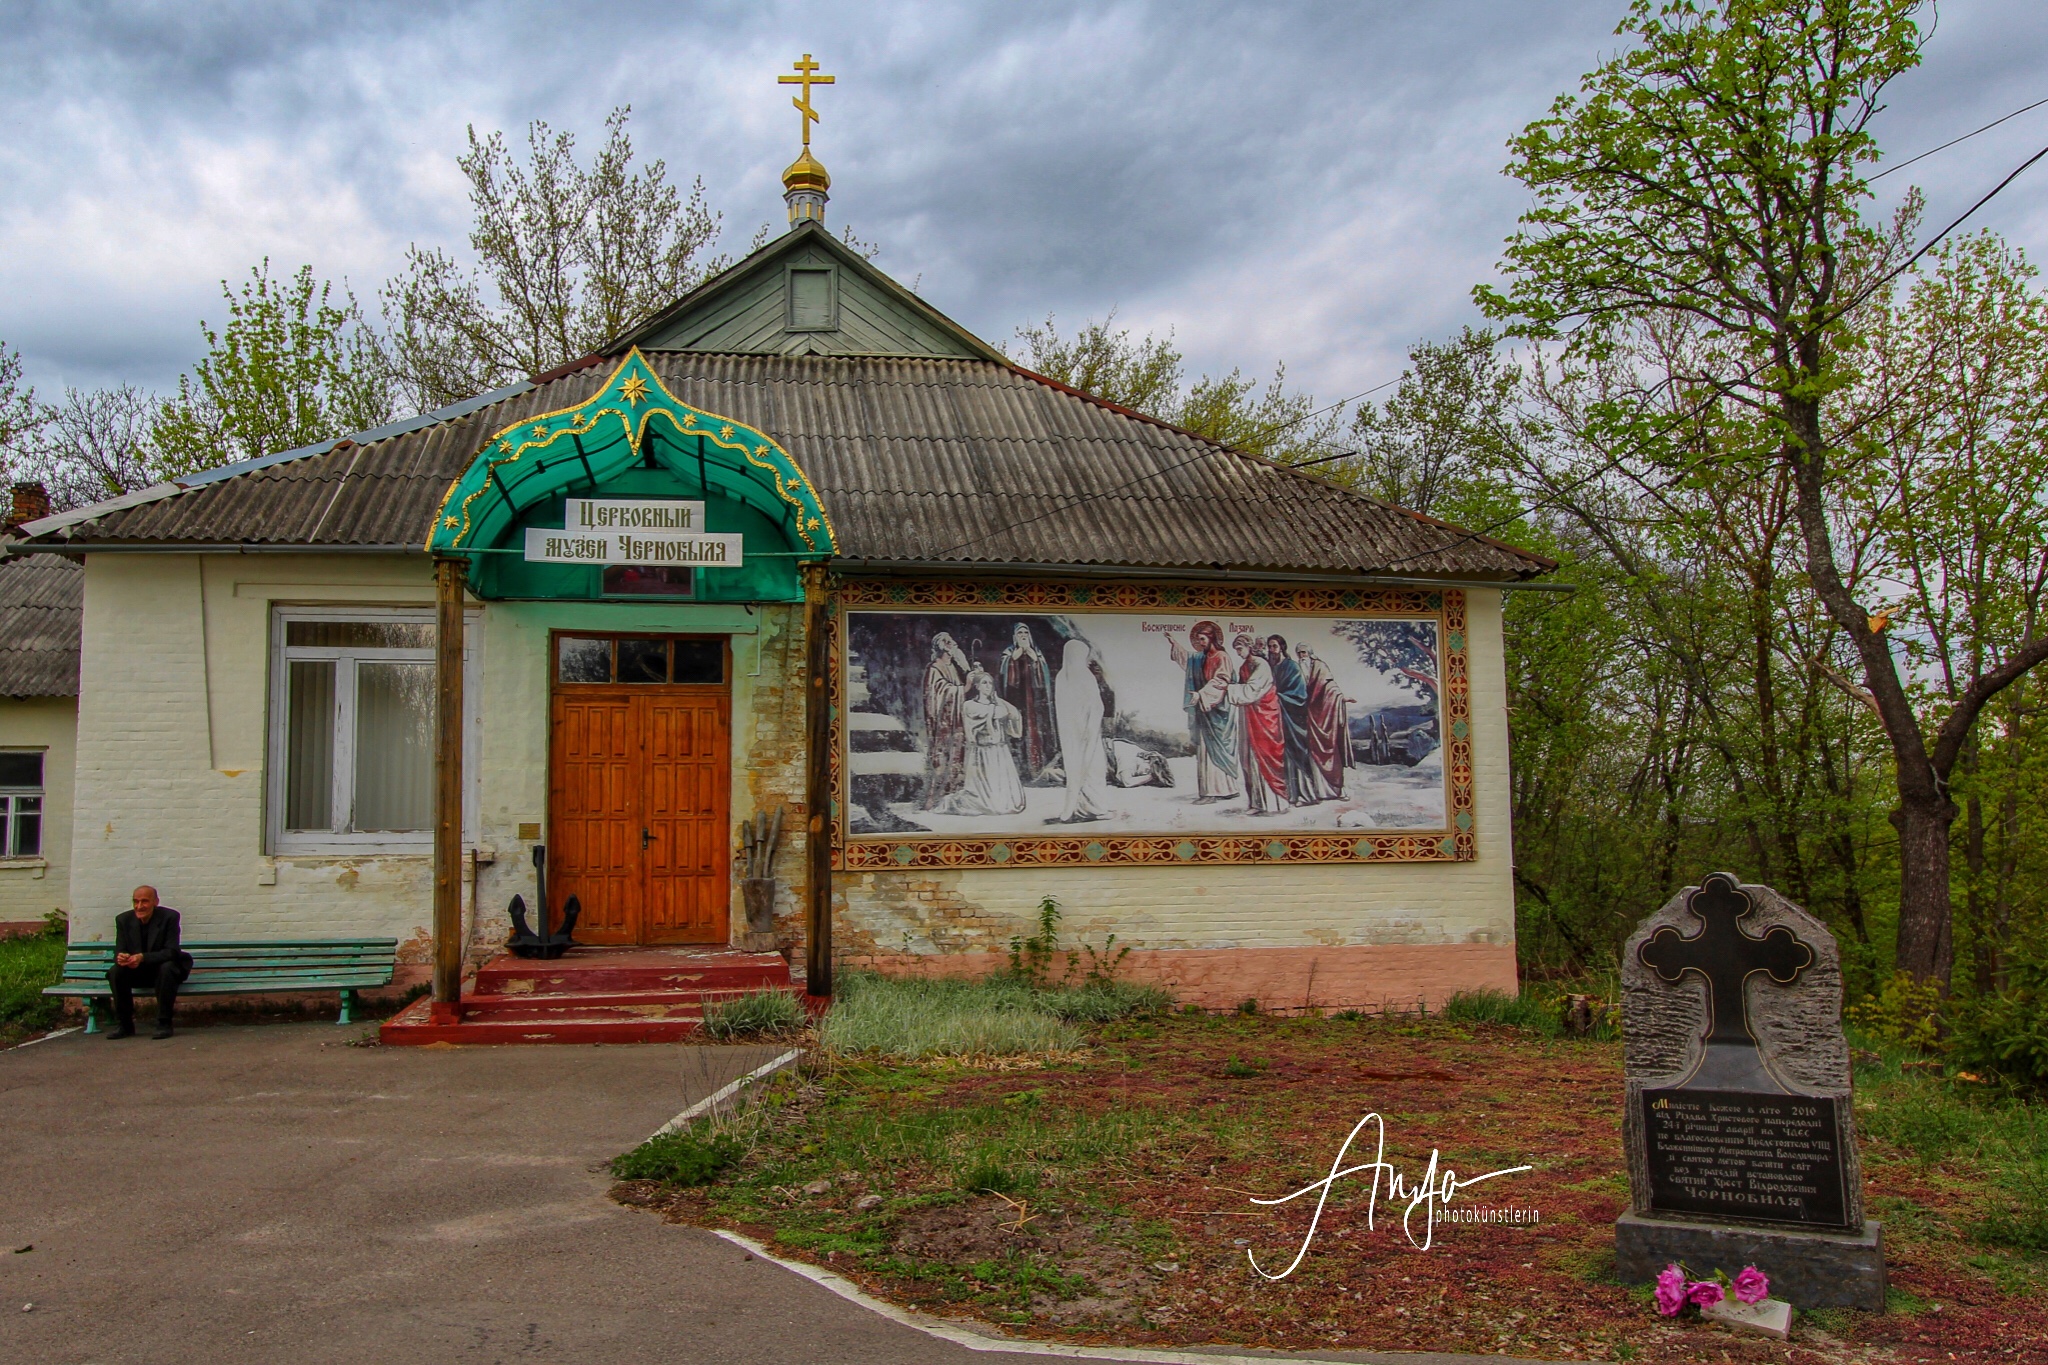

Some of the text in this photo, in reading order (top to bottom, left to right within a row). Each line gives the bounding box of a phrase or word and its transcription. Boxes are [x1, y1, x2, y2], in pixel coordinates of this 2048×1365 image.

[1759, 1105, 1780, 1114] літо
[1792, 1107, 1816, 1116] 2010
[1792, 1162, 1811, 1171] світ
